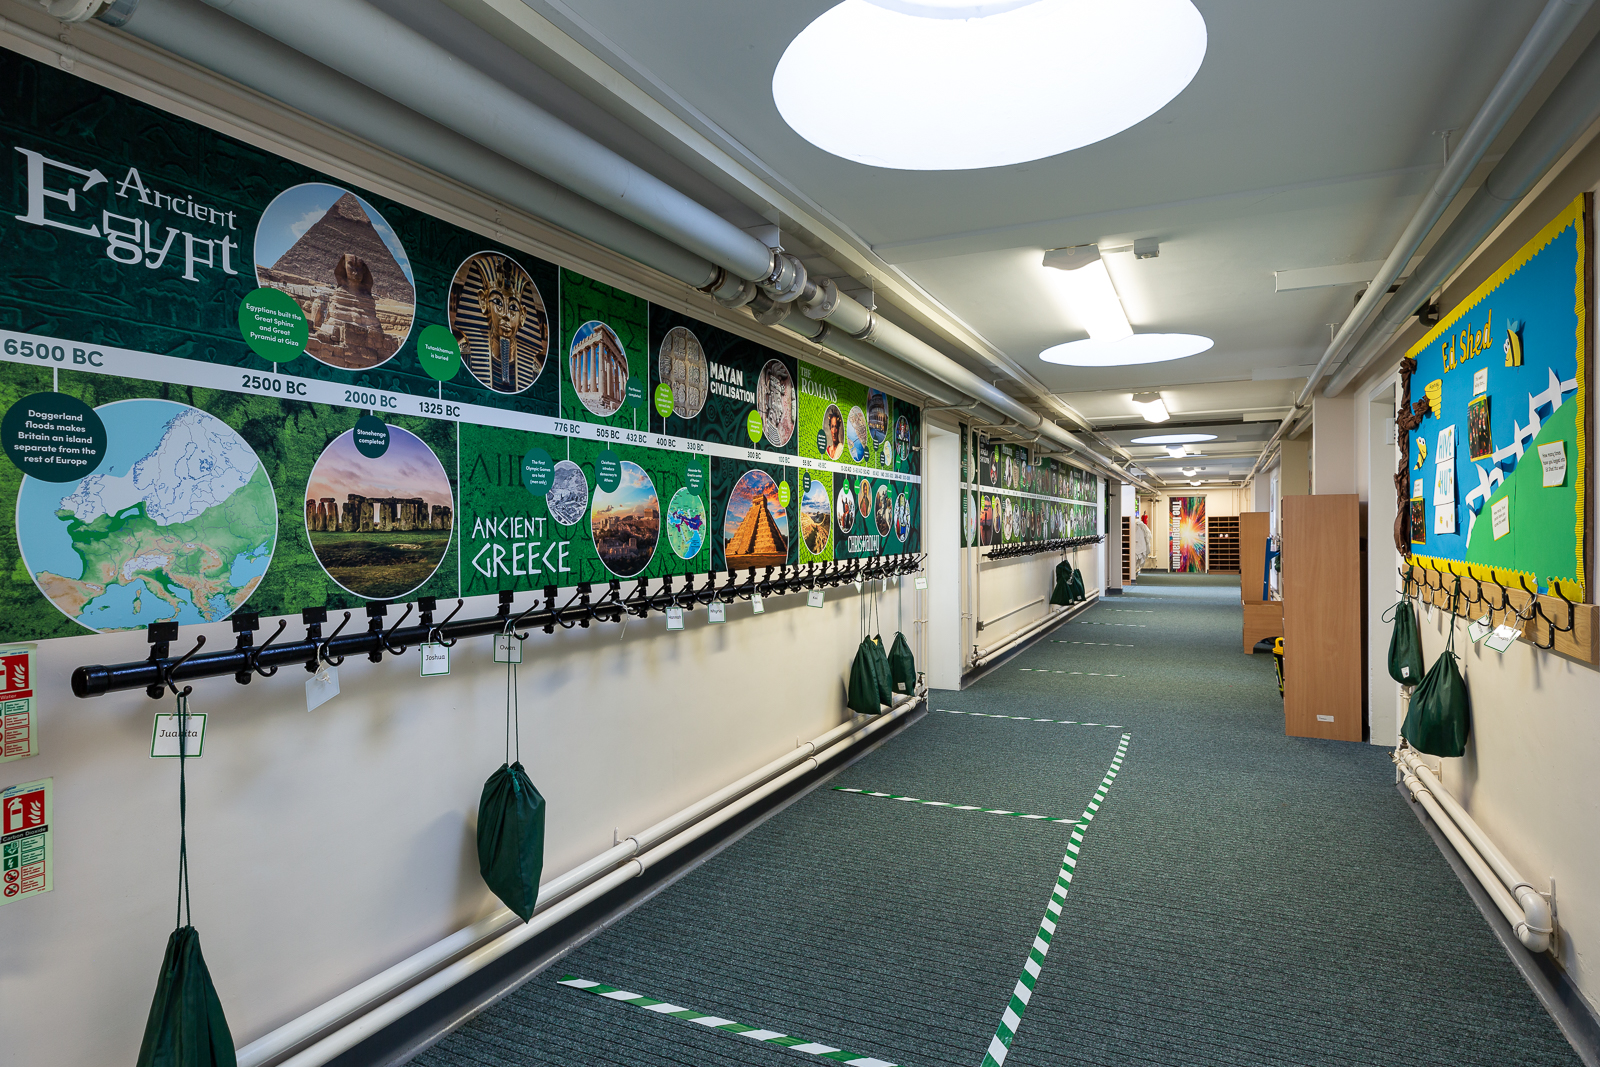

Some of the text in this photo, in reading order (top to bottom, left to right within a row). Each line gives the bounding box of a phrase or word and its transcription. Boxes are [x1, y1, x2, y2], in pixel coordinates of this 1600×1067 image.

[116, 167, 237, 230] Ancient
[14, 146, 238, 282] Egypt
[245, 302, 302, 322] Egyptians built the
[254, 314, 295, 329] Great Sphinx
[259, 325, 291, 336] and Great
[250, 331, 299, 347] Pyramid at Giza
[1441, 308, 1494, 375] Ed Shed
[3, 338, 105, 368] 6500 BC
[435, 353, 450, 362] buried
[709, 361, 744, 387] MAYAN
[800, 366, 812, 379] THE
[241, 374, 308, 396] 2500 BC
[801, 377, 838, 404] ROMANS
[344, 390, 398, 409] 2000 BC
[709, 381, 756, 405] CIVILISATION
[28, 409, 83, 423] Doggerland
[418, 401, 461, 418] 1325 BC
[25, 420, 86, 433] floods makes
[356, 428, 386, 438] Stonehenge
[554, 421, 581, 435] 776 BC
[596, 428, 620, 440] 505 BC
[18, 431, 50, 442] Britain
[65, 434, 93, 444] island
[358, 438, 385, 446] completed
[626, 433, 648, 444] 432 BC
[656, 437, 676, 448] 400 BC
[14, 444, 96, 456] separate from the
[686, 441, 704, 452] 330 BC
[24, 455, 88, 466] rest of Europe
[747, 451, 762, 460] 300 BC
[1439, 468, 1452, 496] HUT
[1172, 500, 1182, 516] The
[471, 516, 547, 539] ANCIENT
[1172, 516, 1182, 570] Imaginarium
[471, 541, 571, 578] GREECE
[425, 653, 446, 661] Joshua
[2, 827, 46, 842] Carbon Dioxide
